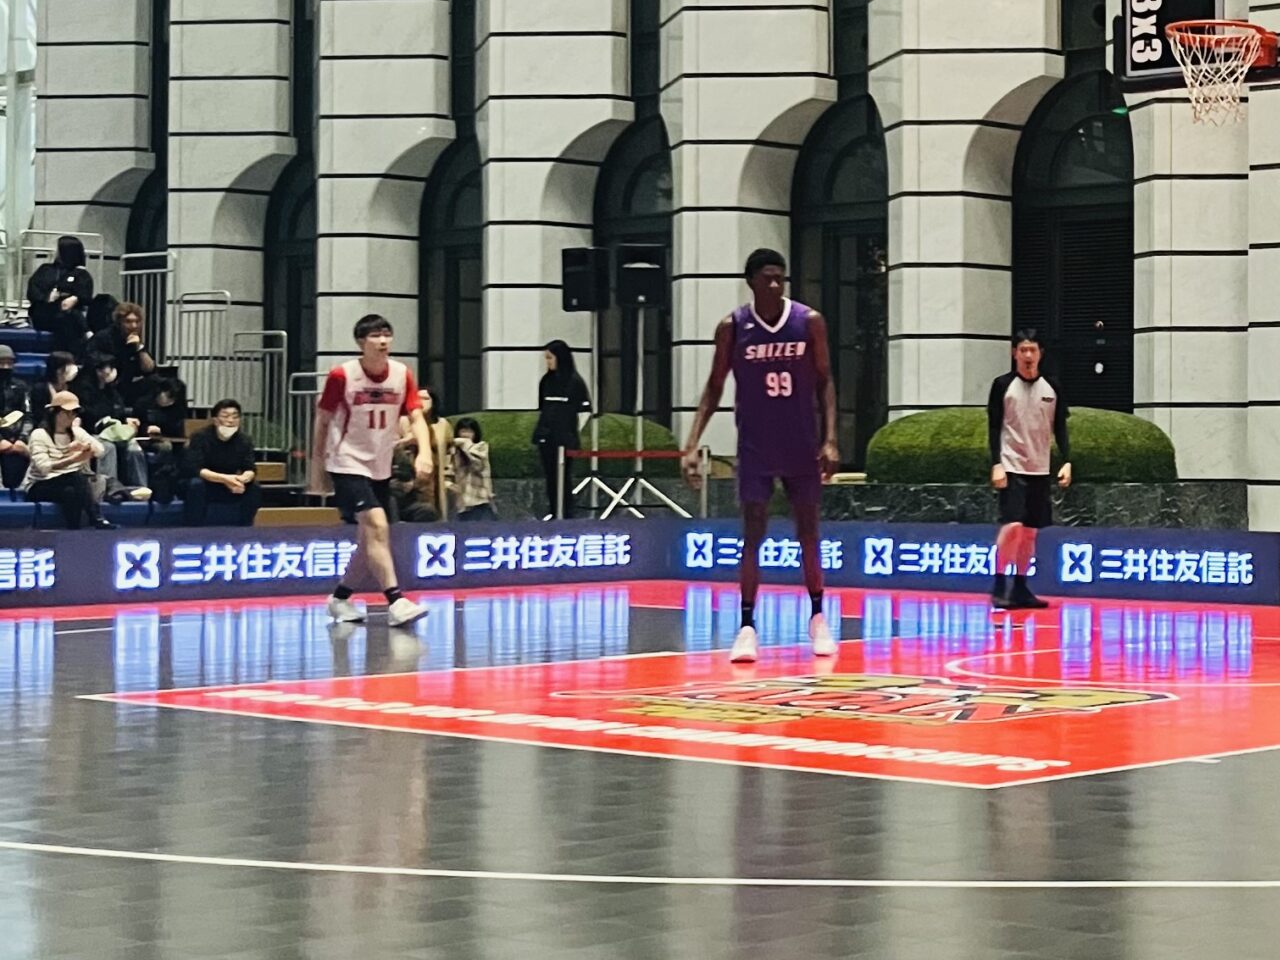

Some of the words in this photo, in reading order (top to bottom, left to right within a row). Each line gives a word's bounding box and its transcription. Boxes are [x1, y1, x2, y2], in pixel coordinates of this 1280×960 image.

[765, 371, 793, 397] 99
[367, 410, 387, 430] 11
[463, 533, 631, 571] 三井住友信託
[897, 541, 1037, 578] 三井住友
[1099, 548, 1254, 585] 三井住友信託
